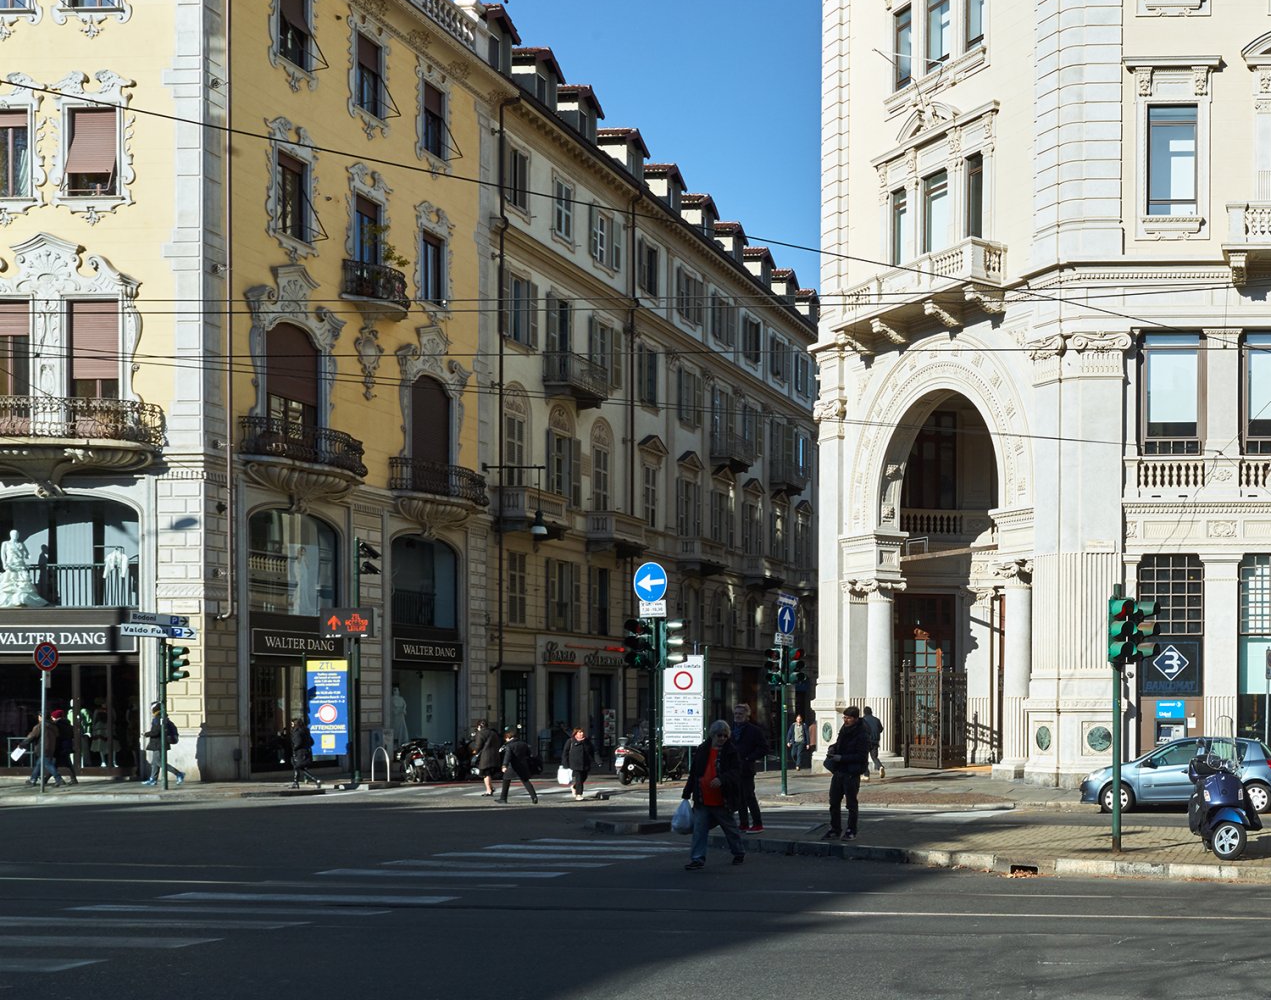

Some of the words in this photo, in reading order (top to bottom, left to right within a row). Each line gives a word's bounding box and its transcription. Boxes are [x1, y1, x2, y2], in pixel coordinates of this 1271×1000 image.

[132, 613, 157, 622] Bodoni
[123, 625, 148, 634] Valdo
[59, 632, 107, 645] DANG
[265, 635, 306, 650] WALTER
[307, 638, 335, 651] DANG
[402, 644, 434, 656] WALTER
[435, 646, 456, 658] DANG
[319, 661, 336, 670] ZTL
[1146, 681, 1195, 690] BANCOMAT
